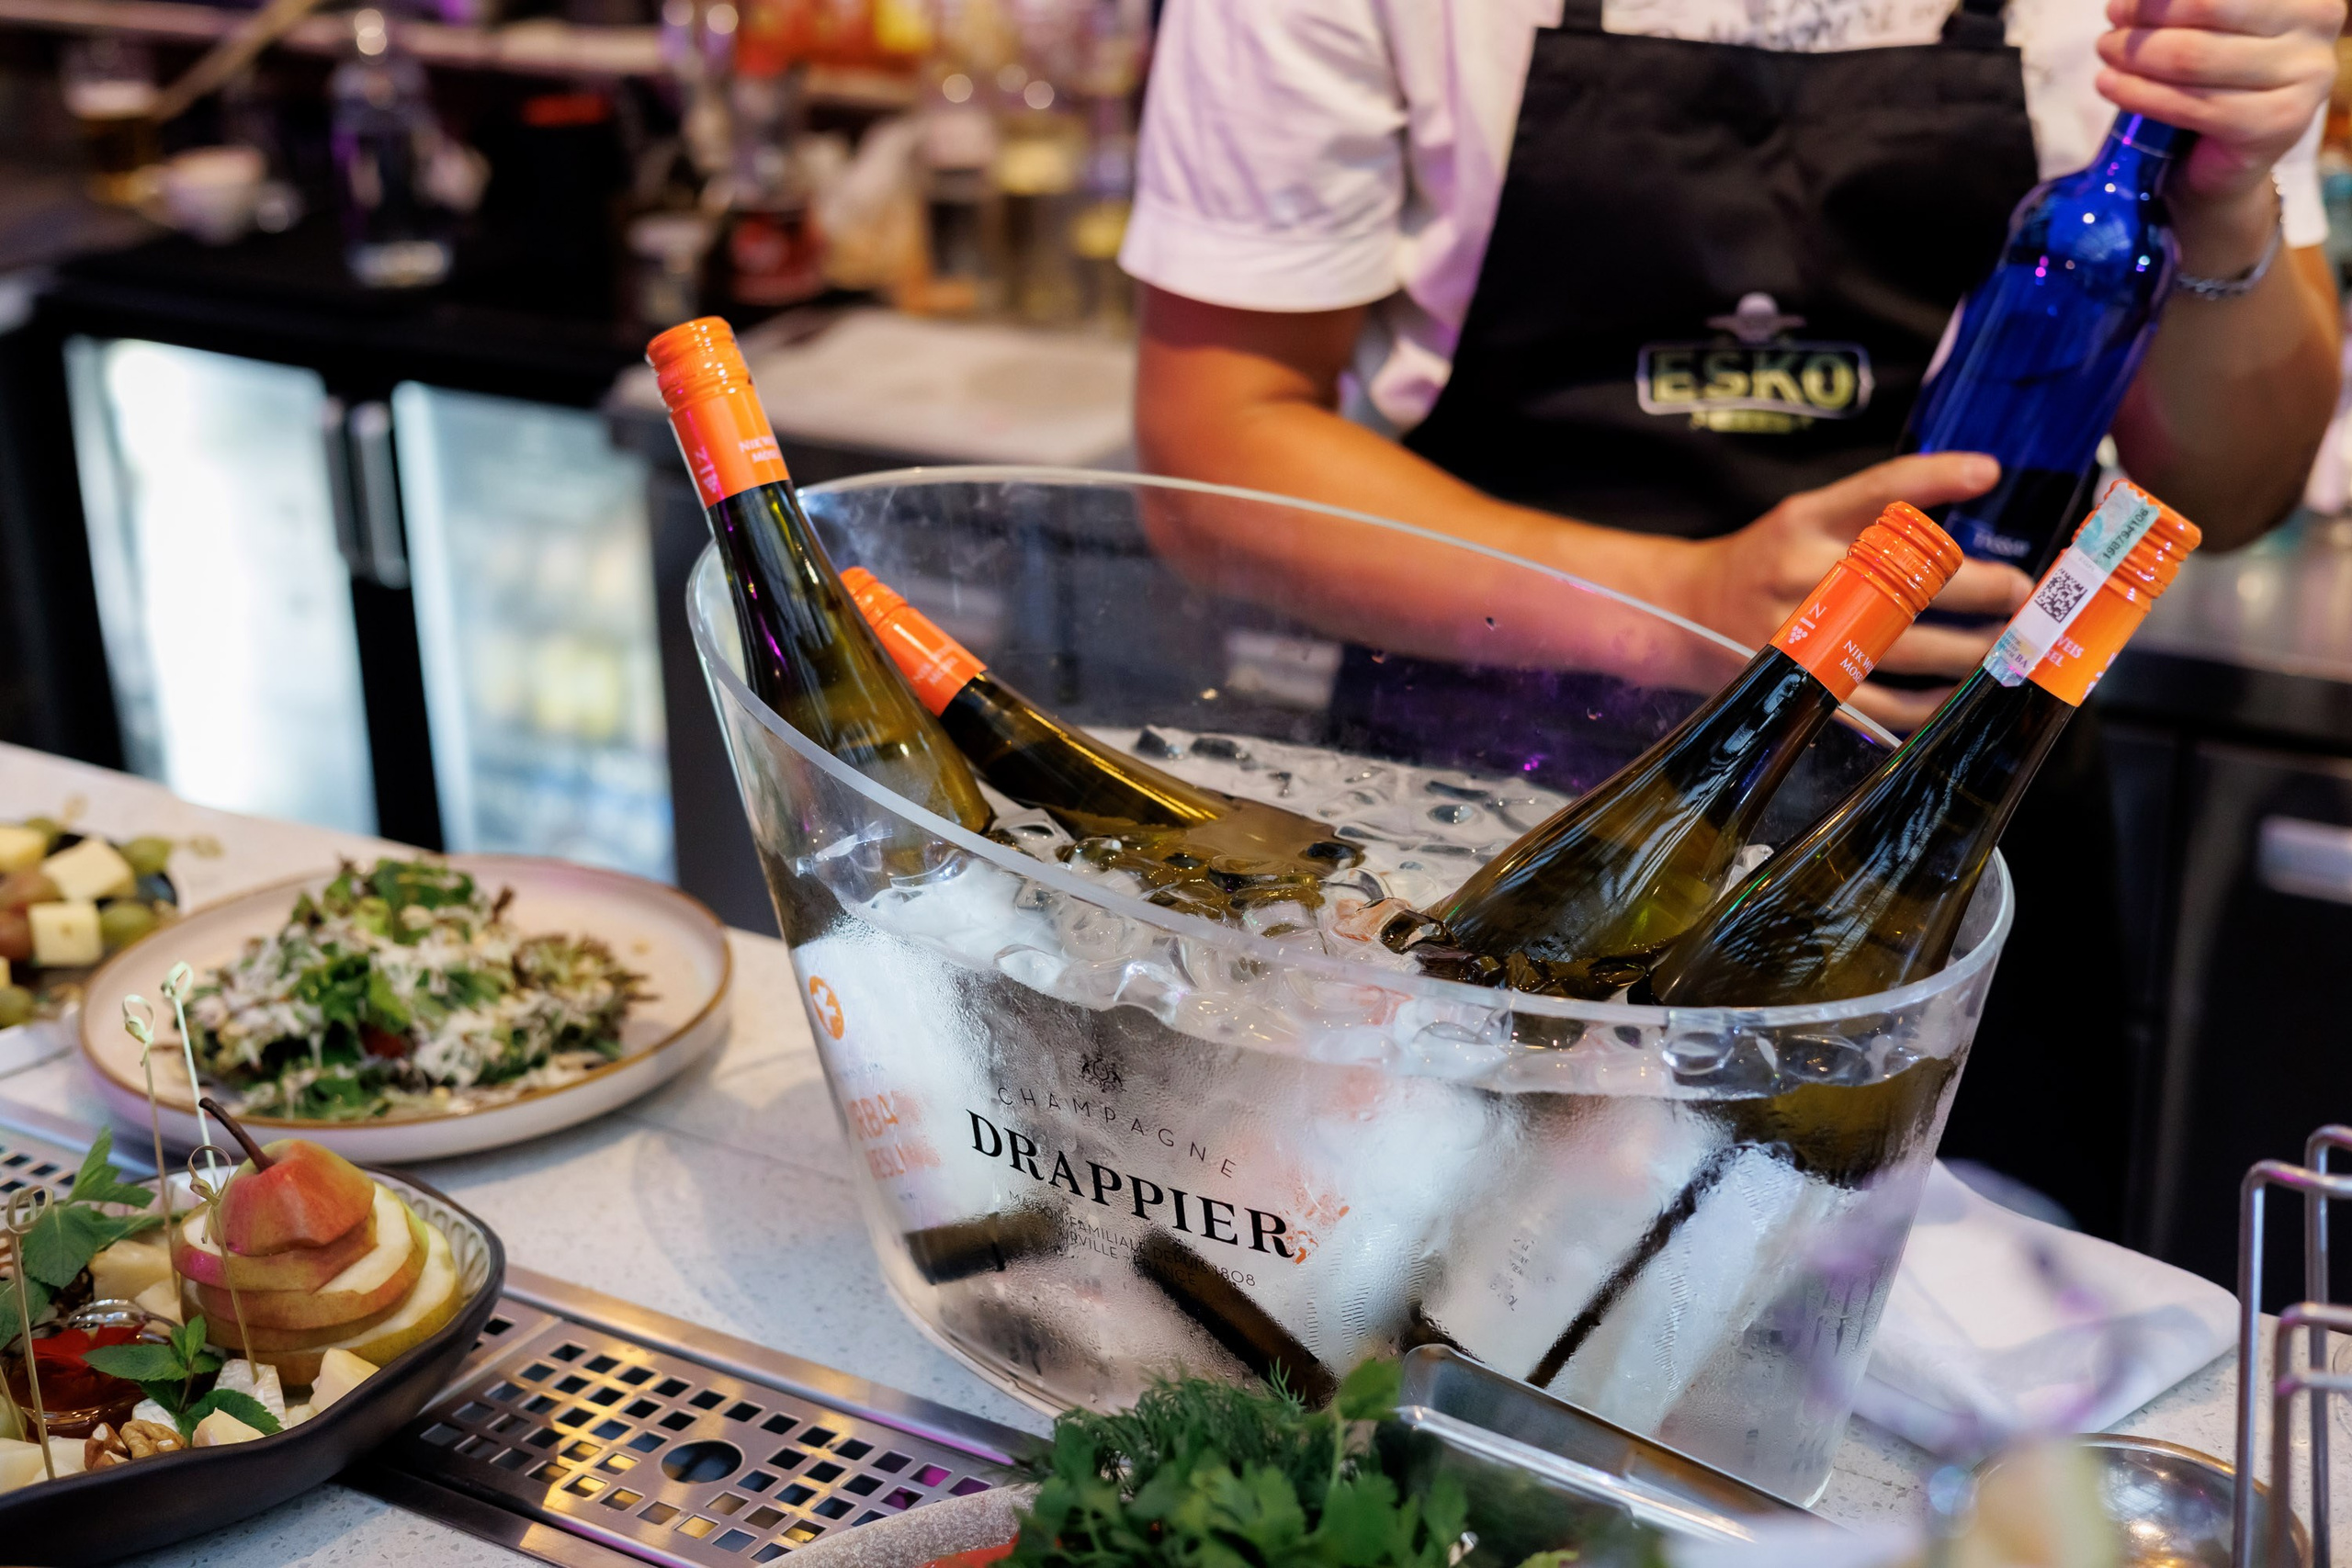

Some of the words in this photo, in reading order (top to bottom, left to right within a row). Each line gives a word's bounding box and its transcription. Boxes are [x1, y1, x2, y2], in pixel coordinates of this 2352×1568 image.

[1654, 349, 1857, 410] ESKO
[1843, 639, 1864, 663] NIK
[998, 1088, 1237, 1179] CHAMPAGNE
[966, 1109, 1295, 1258] DRAPPIER
[1152, 1246, 1209, 1274] DEPUIS
[1214, 1264, 1257, 1287] 1808
